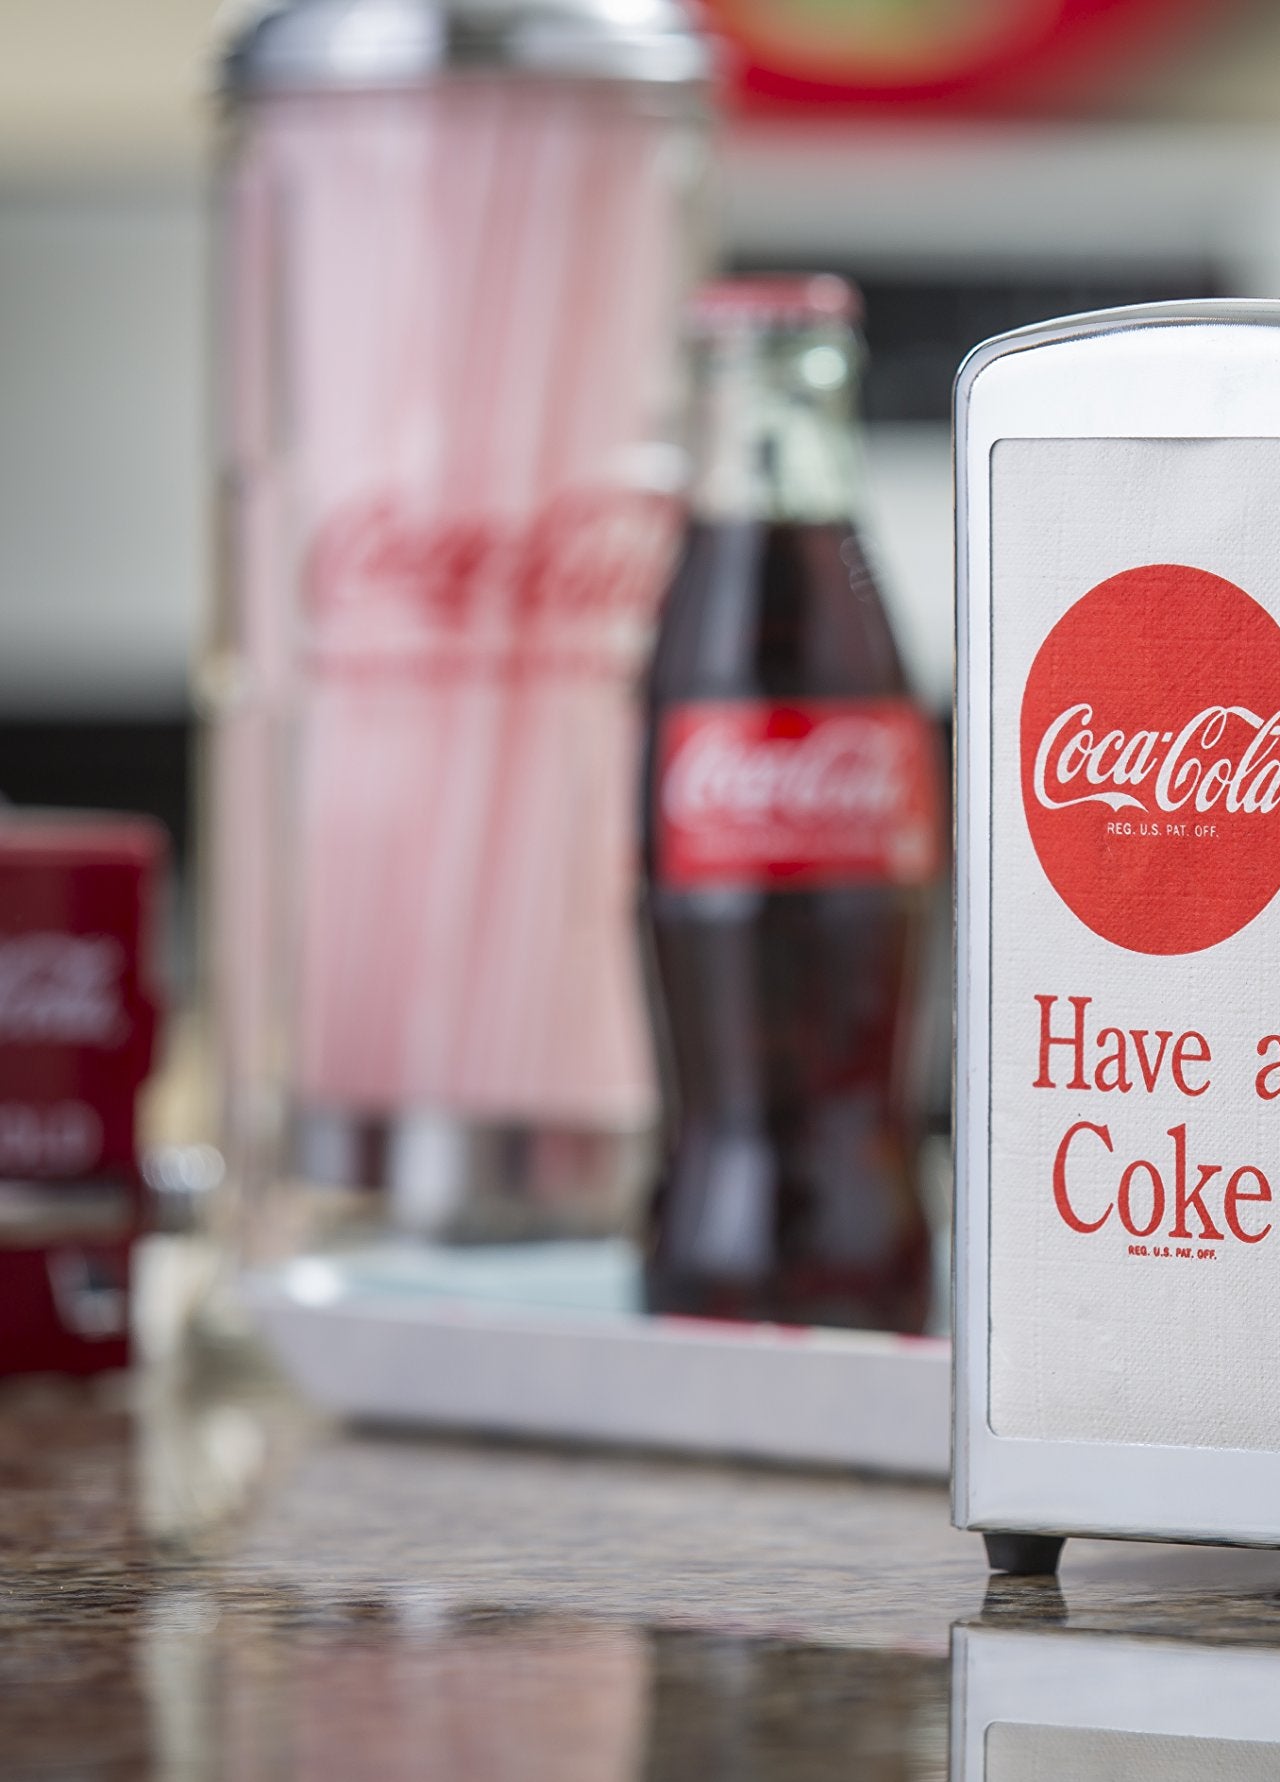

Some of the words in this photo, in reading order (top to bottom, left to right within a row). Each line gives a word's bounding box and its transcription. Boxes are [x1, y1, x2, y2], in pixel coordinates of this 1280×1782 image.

[1107, 822, 1136, 836] REG.
[1140, 823, 1162, 837] U.S.
[1166, 824, 1190, 838] PAT.
[1194, 824, 1219, 839] OFF.
[1032, 993, 1212, 1097] Have
[1052, 1120, 1273, 1244] Coke
[1175, 1247, 1195, 1260] PAT.
[1196, 1248, 1218, 1261] OFF.
